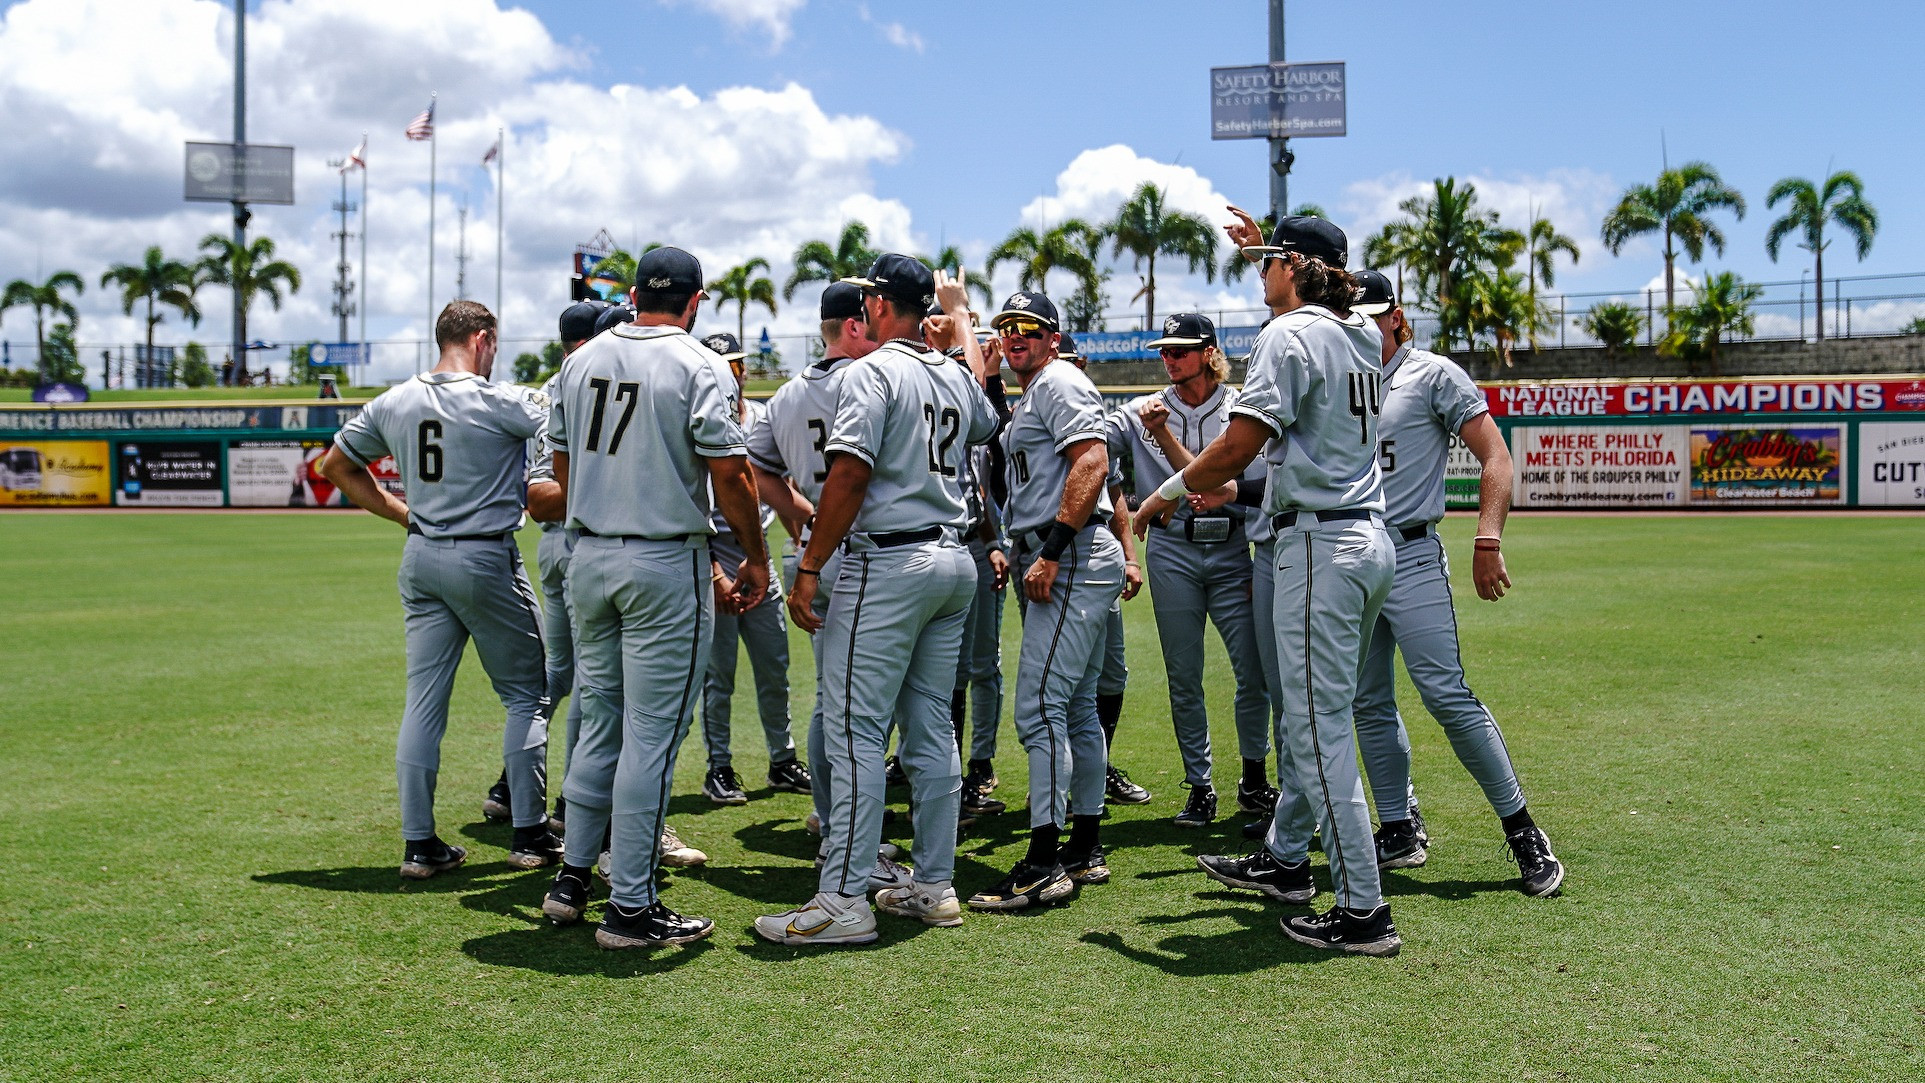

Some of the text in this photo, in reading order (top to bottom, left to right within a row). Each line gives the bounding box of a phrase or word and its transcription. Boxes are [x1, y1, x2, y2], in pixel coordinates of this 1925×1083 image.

[1215, 71, 1342, 89] SAFETY HARBOR
[1216, 92, 1341, 107] RESORT AND SPA
[1215, 118, 1341, 133] SafetyHarborSpa.com
[1075, 337, 1151, 355] obaccoFr
[1500, 387, 1614, 401] NATIONAL
[1623, 383, 1883, 412] CHAMPIONS
[586, 376, 640, 456] 17
[1347, 370, 1380, 445] 44
[1508, 401, 1607, 416] LEAGUE
[58, 412, 131, 430] BASEBALL
[133, 410, 246, 429] CHAMPIONSHIP
[924, 403, 961, 478] 22
[1539, 433, 1663, 449] WHERE PHILLY
[418, 419, 444, 484] 6
[1526, 451, 1677, 466] MEETS PHLORIDA
[1706, 432, 1818, 469] Crabby's
[1521, 470, 1681, 484] HOME OF THE GROUPER PHILLY
[1701, 467, 1829, 483] HIDEAWAY
[1873, 462, 1925, 482] CUT
[1529, 491, 1664, 502] CrabbysHideaway.com
[1715, 486, 1816, 499] Clearwater Beach
